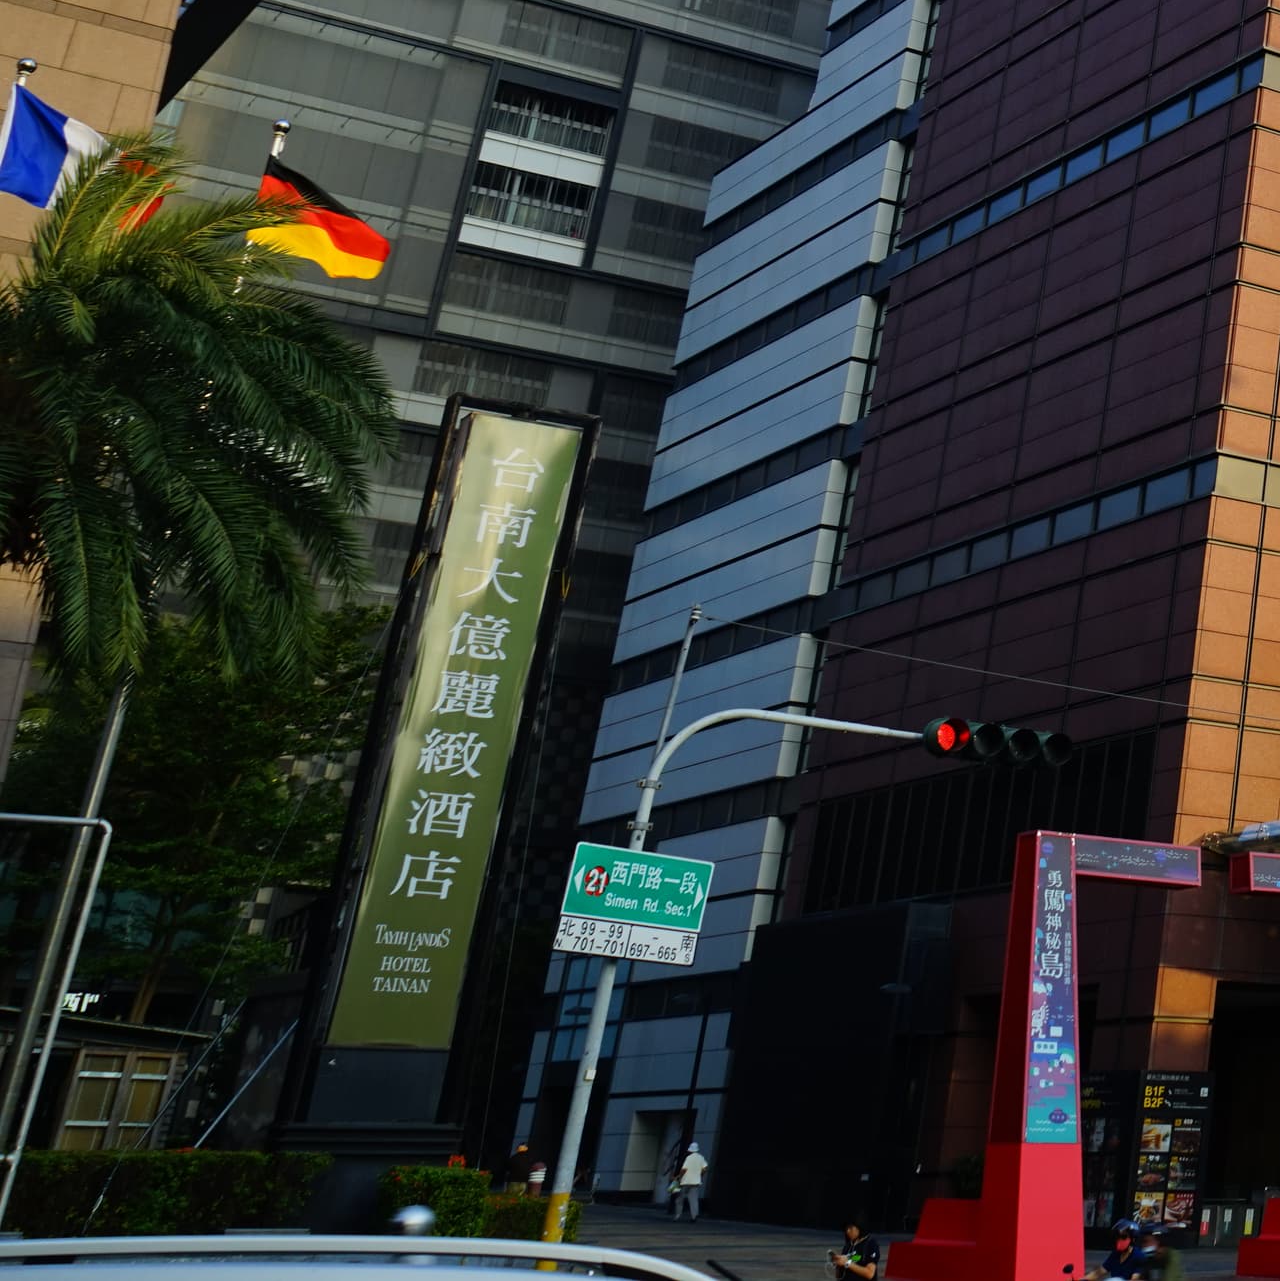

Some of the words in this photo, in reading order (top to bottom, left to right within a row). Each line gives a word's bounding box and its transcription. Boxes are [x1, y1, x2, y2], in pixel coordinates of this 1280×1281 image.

[389, 447, 545, 901] 台南大億麗緻酒店
[585, 867, 608, 894] 21
[609, 860, 698, 895] 西門路一段
[604, 892, 638, 910] Simen
[643, 897, 660, 913] Rd.
[559, 919, 574, 937] 北
[1039, 870, 1065, 979] 勇闖神秘島
[630, 943, 677, 961] 697-665
[680, 935, 695, 952] 南
[380, 956, 431, 973] HOTEL
[373, 977, 432, 993] TAINAN
[1144, 1085, 1166, 1097] B1F
[1143, 1097, 1165, 1109] B2F
